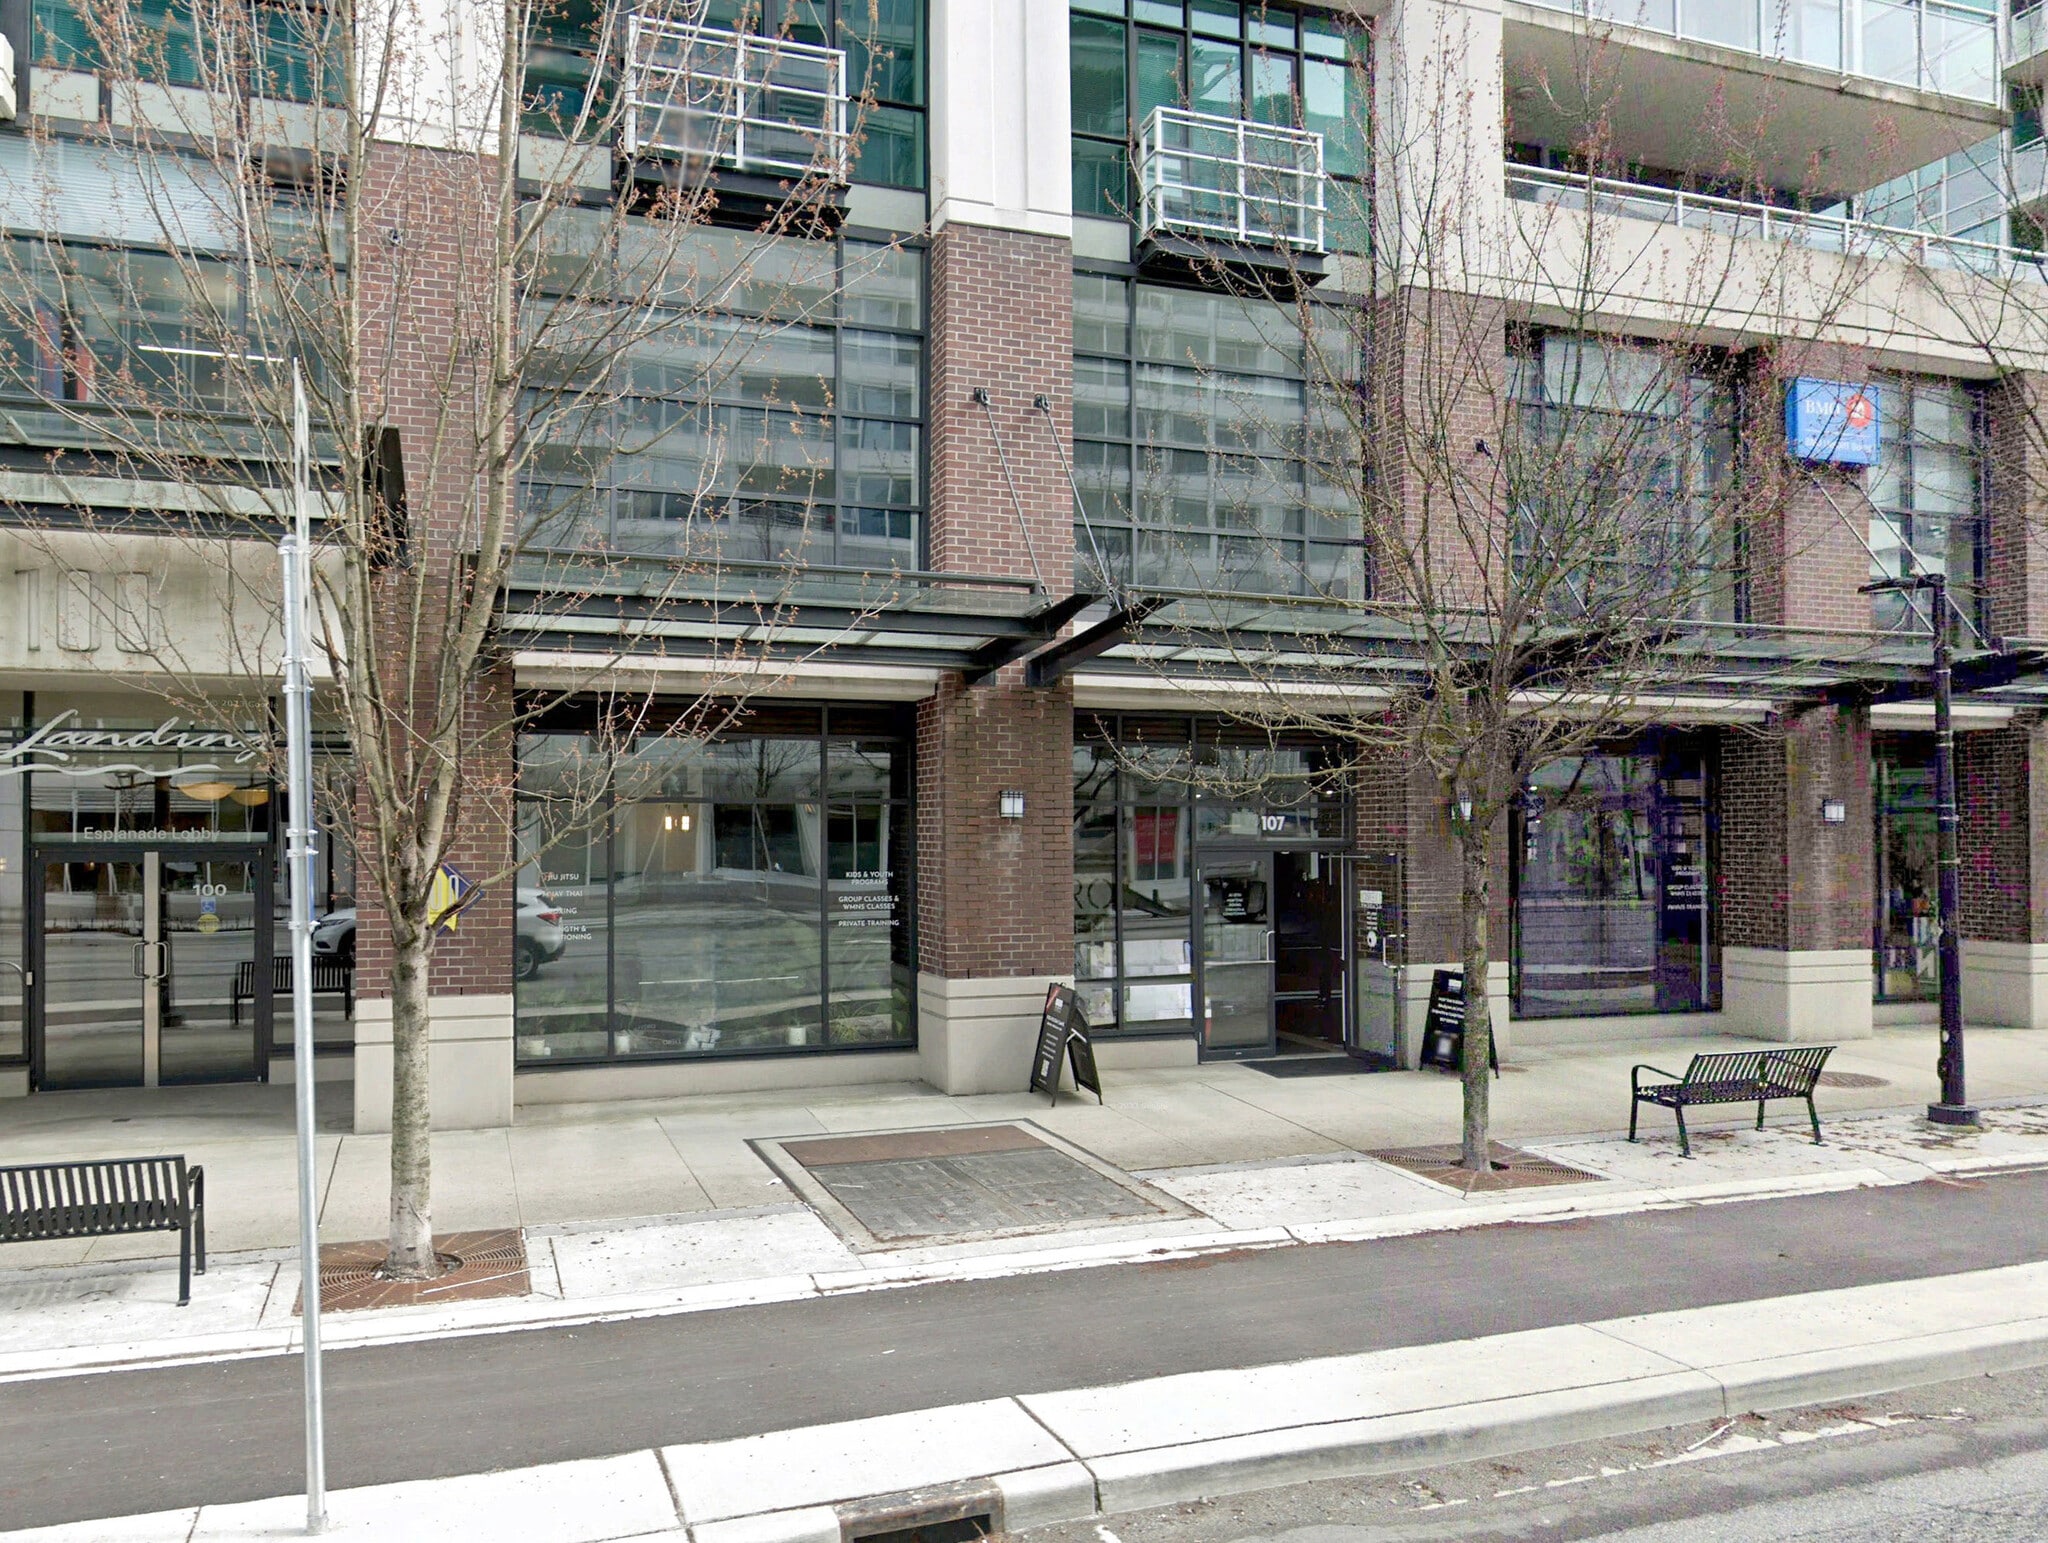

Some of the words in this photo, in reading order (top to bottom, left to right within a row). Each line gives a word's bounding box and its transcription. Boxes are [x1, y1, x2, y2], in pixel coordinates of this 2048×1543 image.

[1261, 815, 1285, 831] 107
[83, 827, 167, 842] Esplanade
[172, 827, 220, 842] Lobby
[560, 873, 580, 881] JITSU
[192, 884, 227, 897] 100
[838, 895, 862, 903] GROUP
